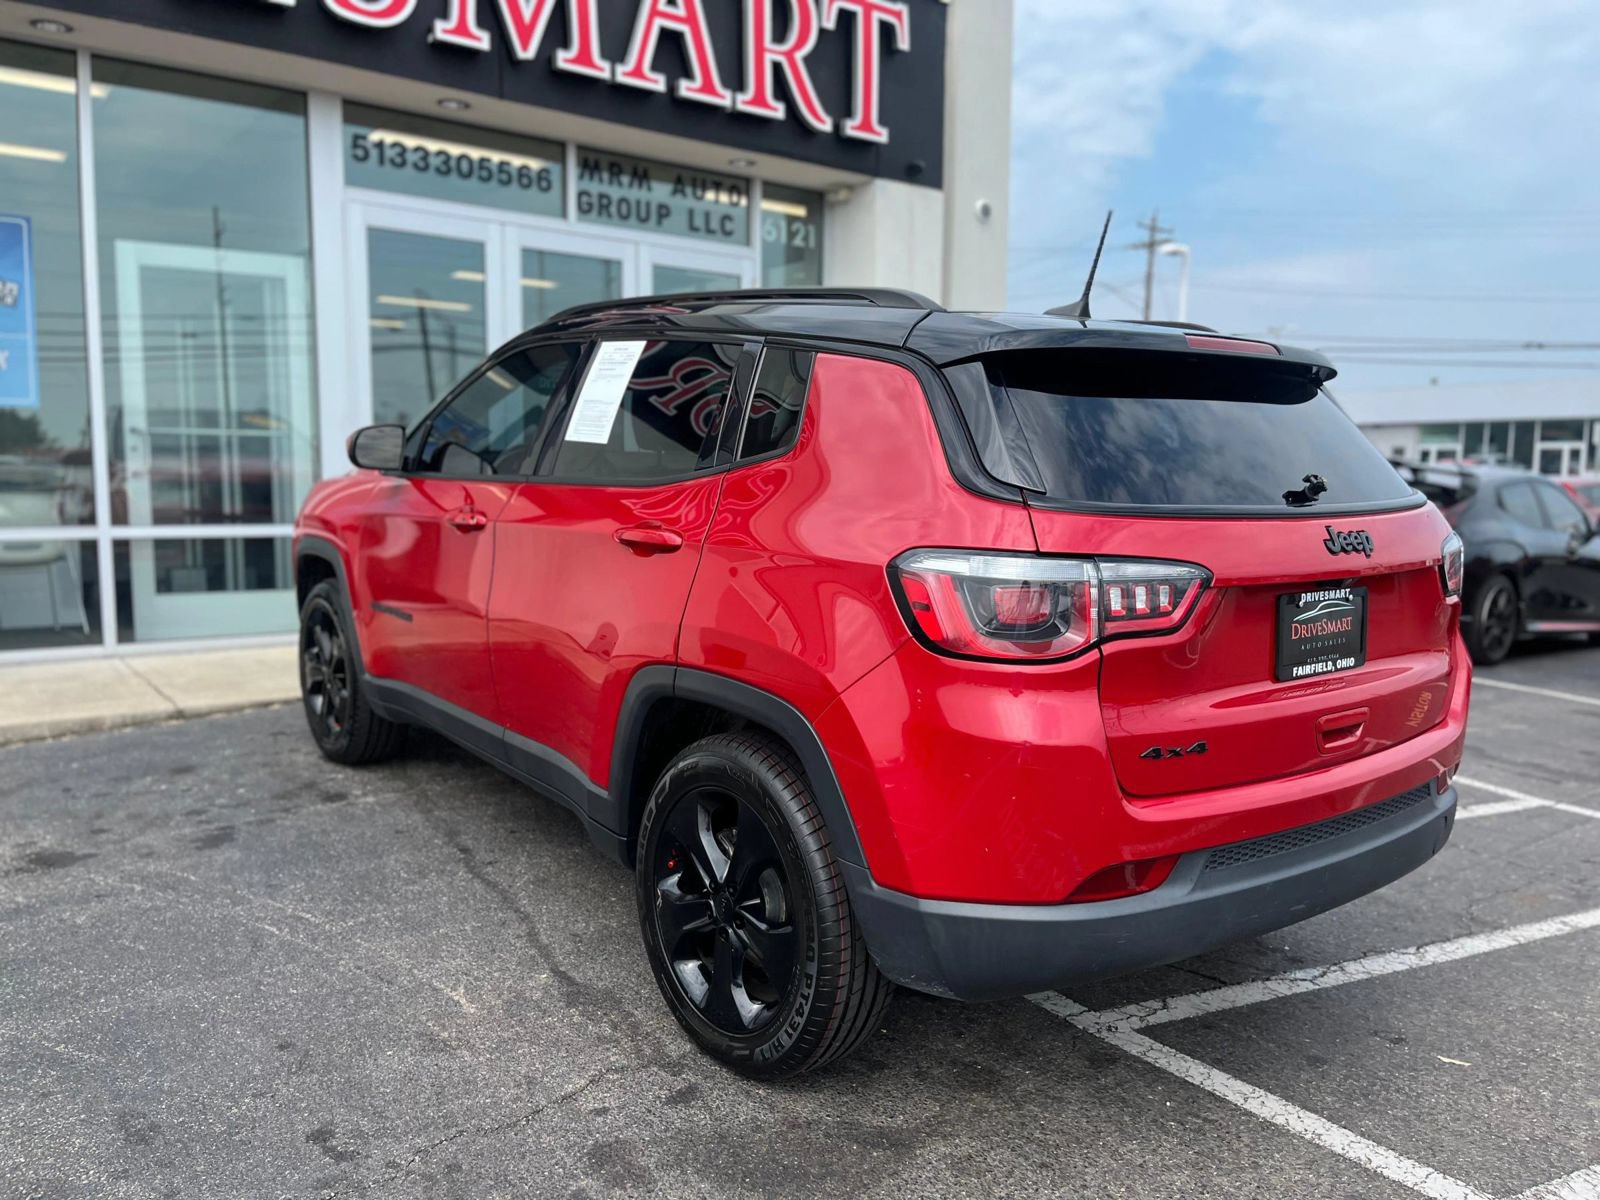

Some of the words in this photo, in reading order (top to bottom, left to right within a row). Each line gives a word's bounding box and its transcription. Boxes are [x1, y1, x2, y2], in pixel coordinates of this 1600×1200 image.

[351, 132, 554, 193] 5133305566
[577, 156, 653, 193] MRM
[671, 173, 743, 207] AUTO
[576, 190, 672, 227] GROUP
[687, 208, 735, 237] LLC
[762, 217, 817, 250] 6121
[1323, 525, 1374, 559] Jeep
[1300, 588, 1351, 602] DRIVESMART
[1300, 641, 1322, 650] AUTO
[1292, 661, 1335, 677] FAIRFIELD,
[1336, 656, 1355, 669] OHIO
[1139, 740, 1208, 759] 4x4
